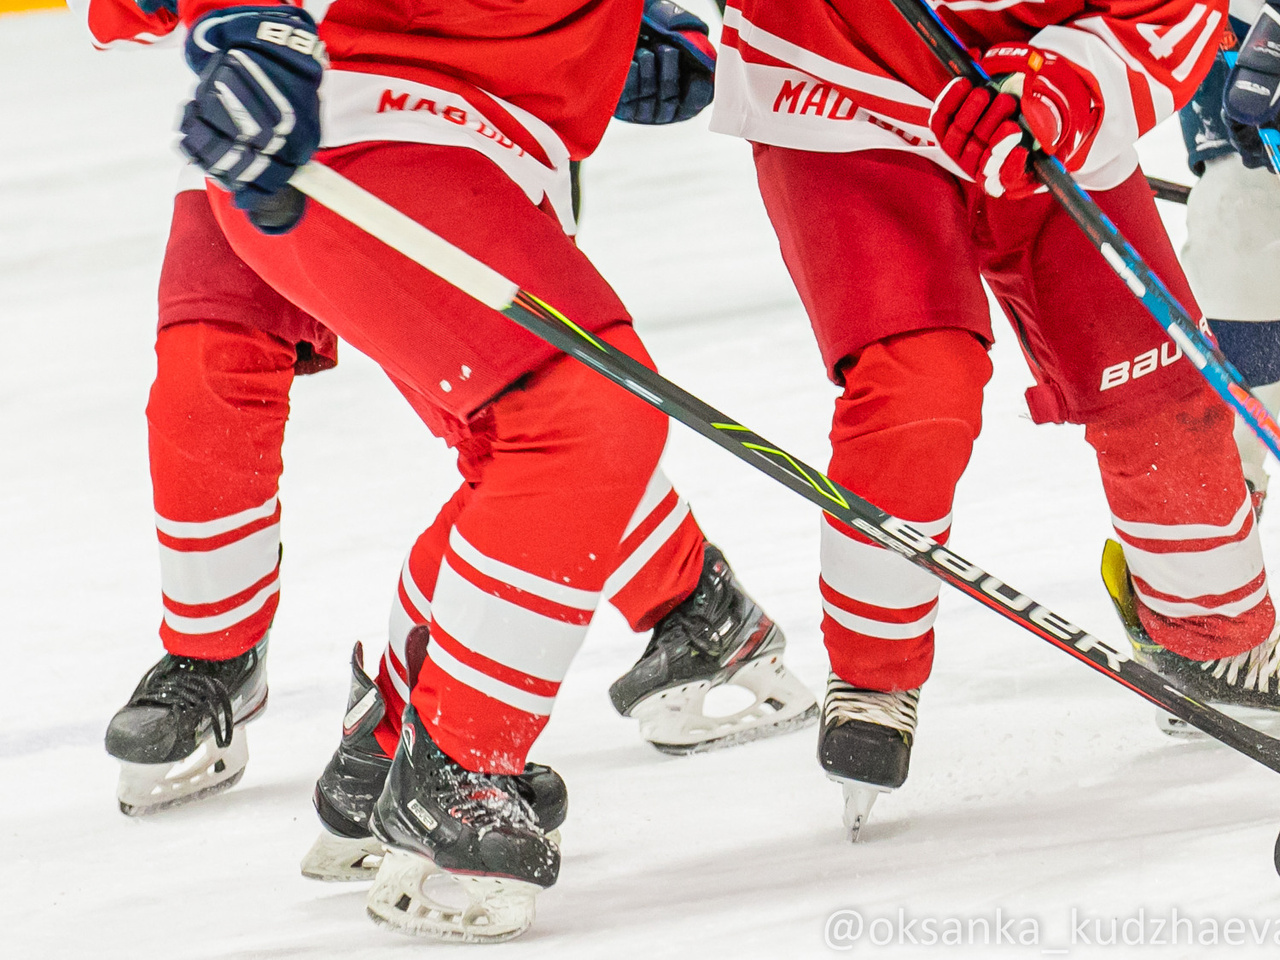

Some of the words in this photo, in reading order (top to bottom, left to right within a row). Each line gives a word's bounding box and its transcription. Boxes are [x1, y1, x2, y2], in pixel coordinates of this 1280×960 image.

[985, 46, 1029, 58] CCM
[1136, 2, 1223, 84] 41
[879, 515, 1131, 673] BAUER
